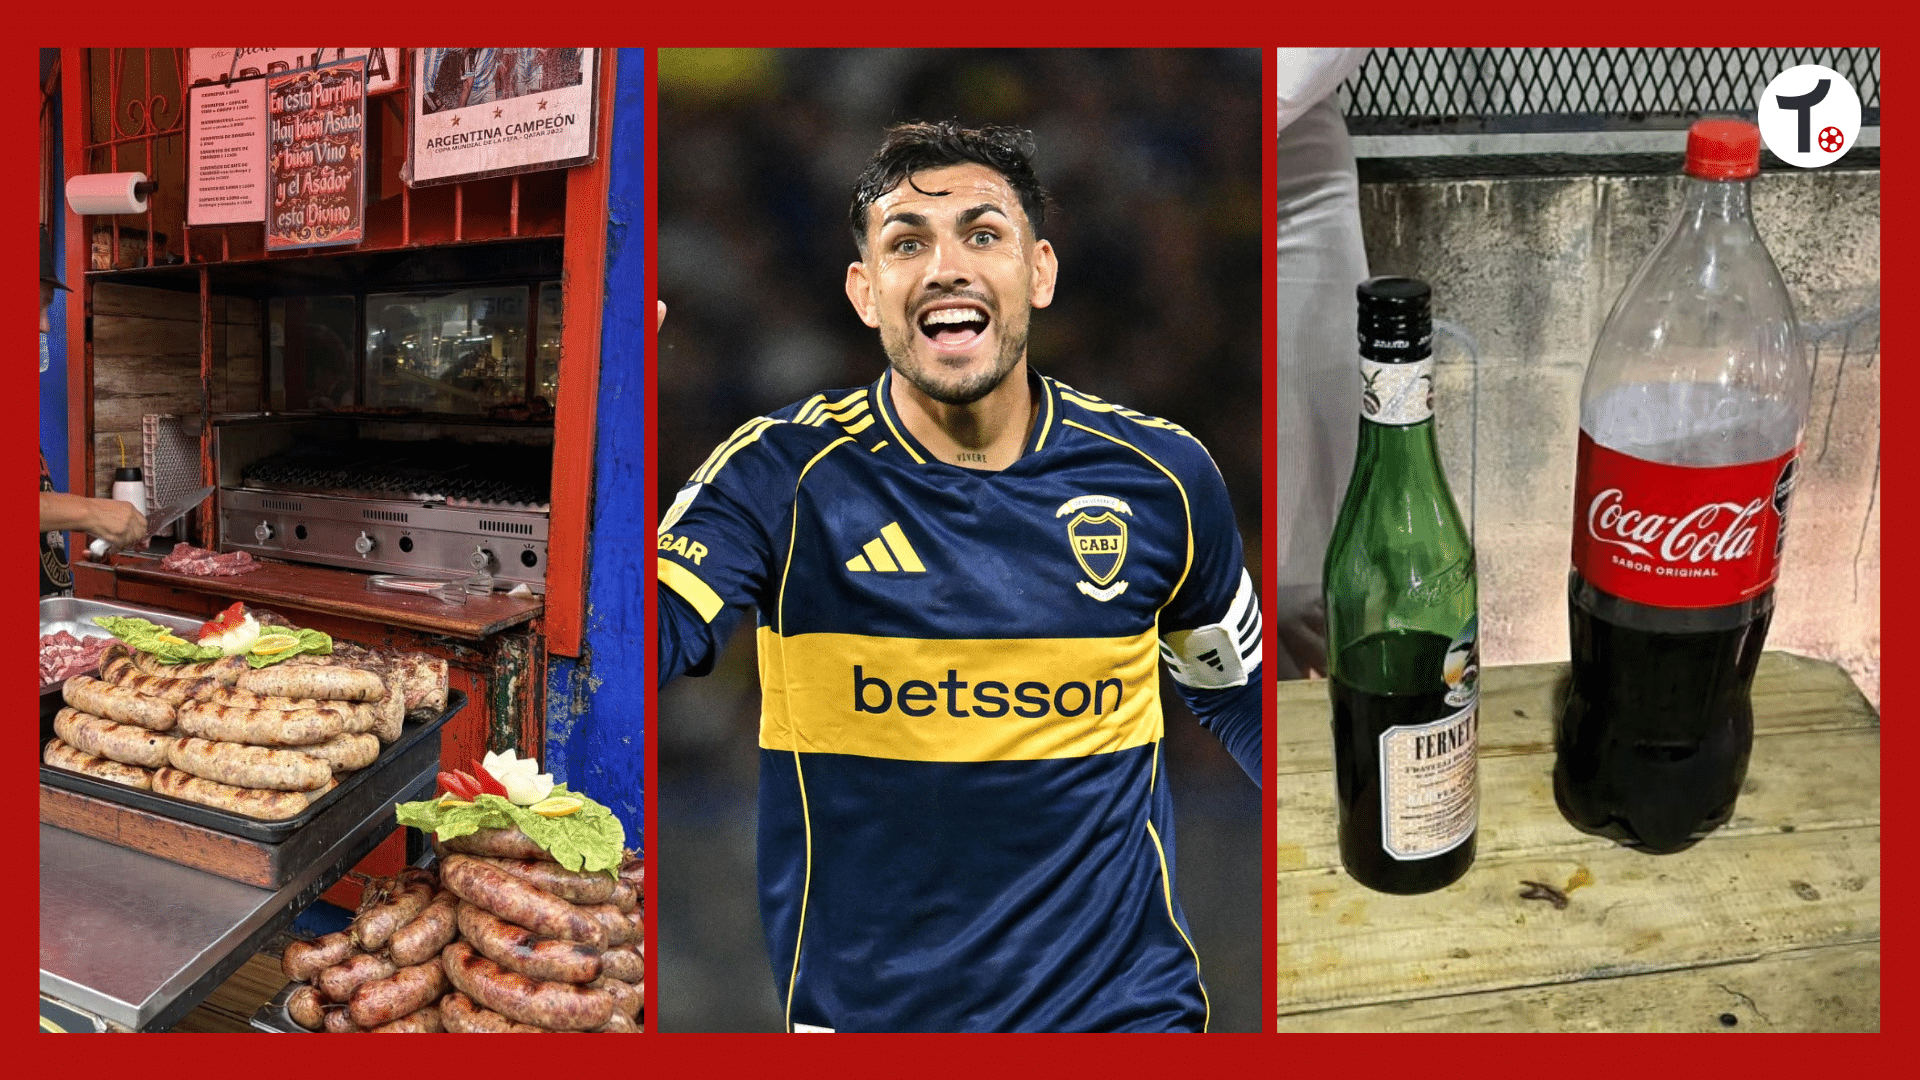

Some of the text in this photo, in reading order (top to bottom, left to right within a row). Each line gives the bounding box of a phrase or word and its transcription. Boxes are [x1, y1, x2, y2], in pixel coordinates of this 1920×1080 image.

[270, 77, 362, 113] En esta Parrilla
[272, 106, 362, 147] Hay buen Asado
[426, 113, 576, 149] ARGENTINA CAMPEÓN
[452, 142, 482, 151] MUNDIAL
[524, 130, 546, 140] QATAR
[546, 128, 564, 136] 2022
[284, 141, 347, 169] buen Vino
[275, 171, 351, 206] y el Asador
[307, 203, 350, 226] Divino
[956, 453, 988, 463] VIVERE
[1588, 488, 1770, 563] Coca-Cola
[1079, 539, 1118, 551] CABJ
[1612, 555, 1719, 578] SABOR ORIGINAL
[853, 664, 1123, 719] betsson
[1415, 716, 1471, 760] FERNET
